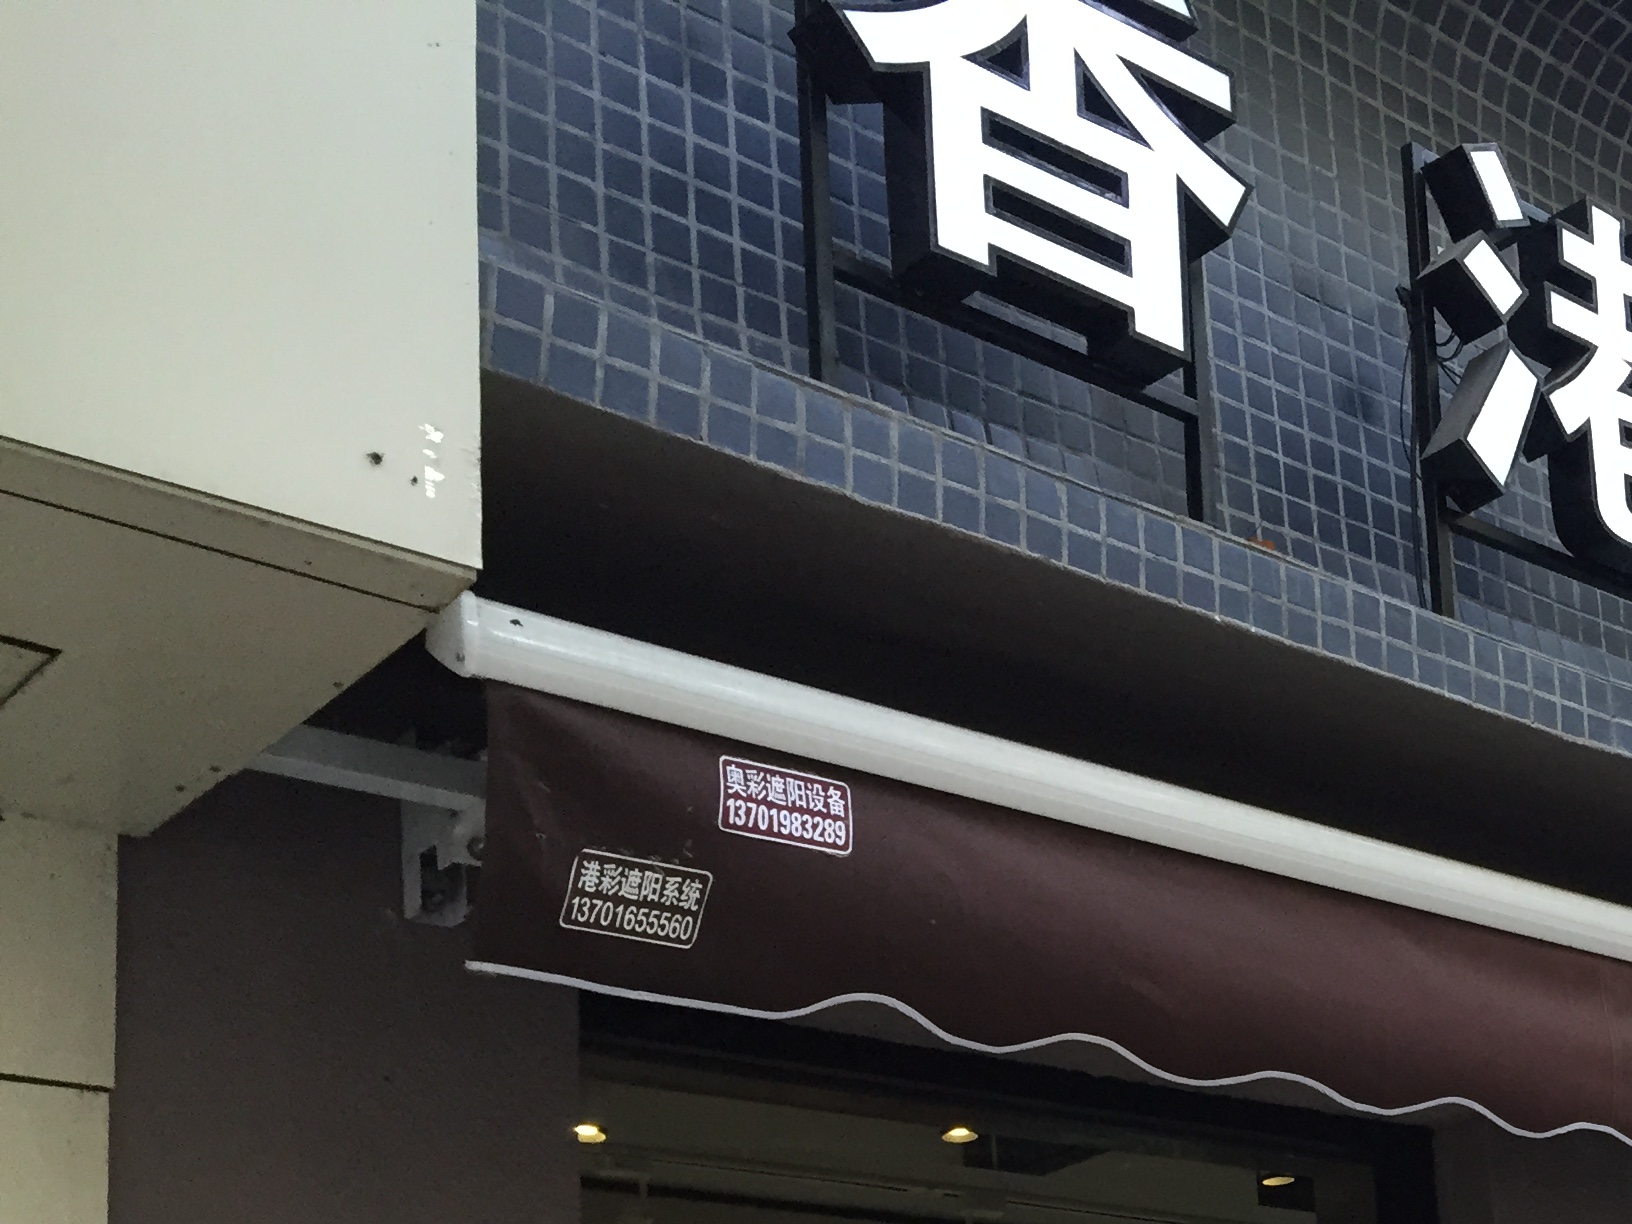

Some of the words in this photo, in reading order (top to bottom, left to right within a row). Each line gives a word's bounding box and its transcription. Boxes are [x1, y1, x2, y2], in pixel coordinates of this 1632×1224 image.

[725, 763, 847, 818] 奥彩遮阳设备
[725, 798, 847, 846] 13701983289
[577, 860, 703, 911] 港彩遮阳系统
[570, 896, 694, 941] 13701655560
